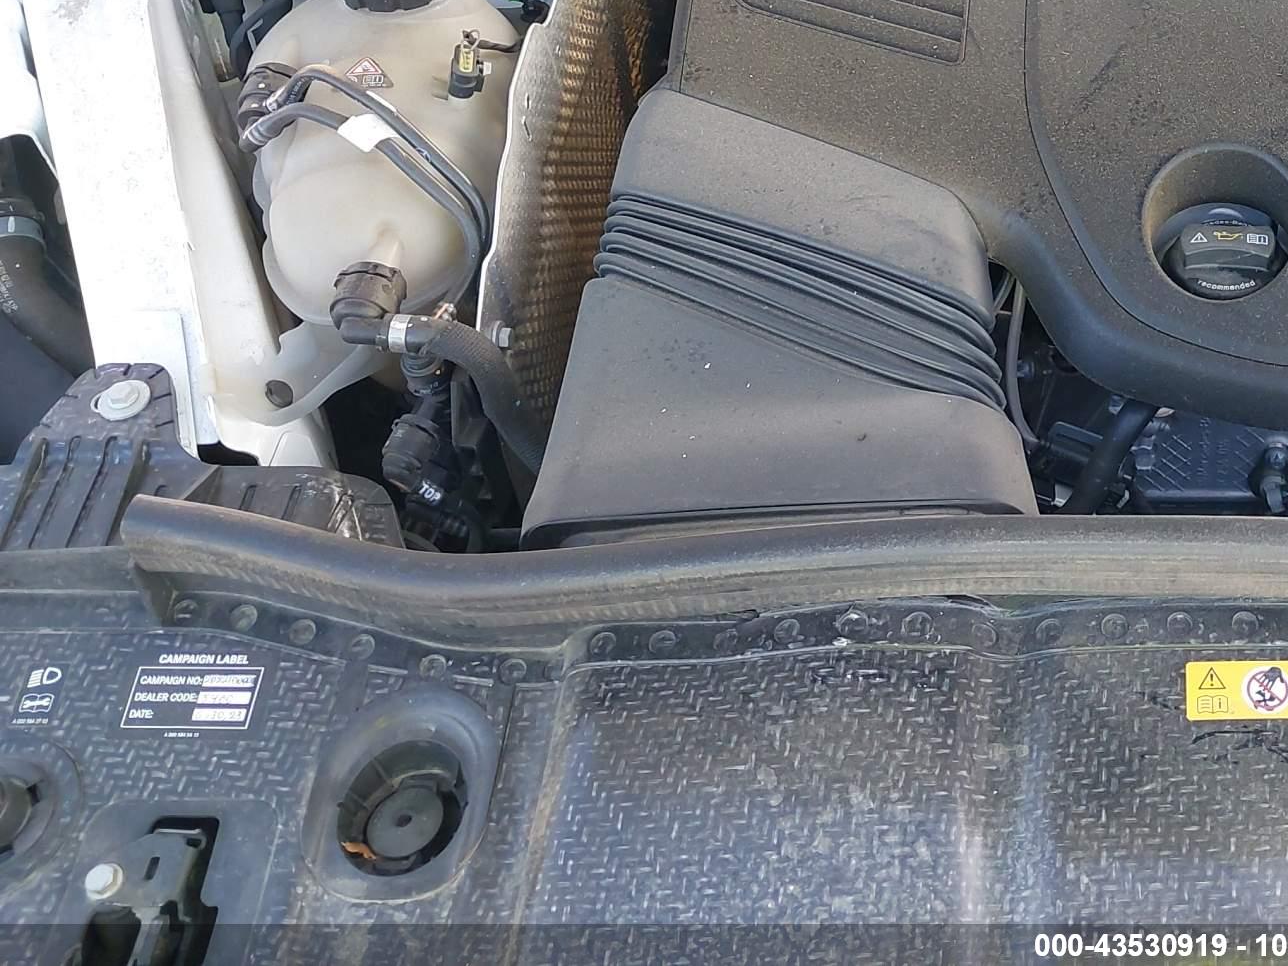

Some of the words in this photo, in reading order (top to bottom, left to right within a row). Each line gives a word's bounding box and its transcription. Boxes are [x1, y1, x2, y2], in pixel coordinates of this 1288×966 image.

[1197, 279, 1256, 291] recommended
[419, 480, 441, 502] TOP
[159, 654, 214, 664] CAMPAIGN
[216, 654, 249, 665] LABEL
[140, 675, 186, 685] CAMPAIGN
[187, 676, 203, 685] NO:
[134, 692, 169, 702] DEALER
[170, 692, 197, 702] CODE:
[129, 709, 154, 719] DATE:
